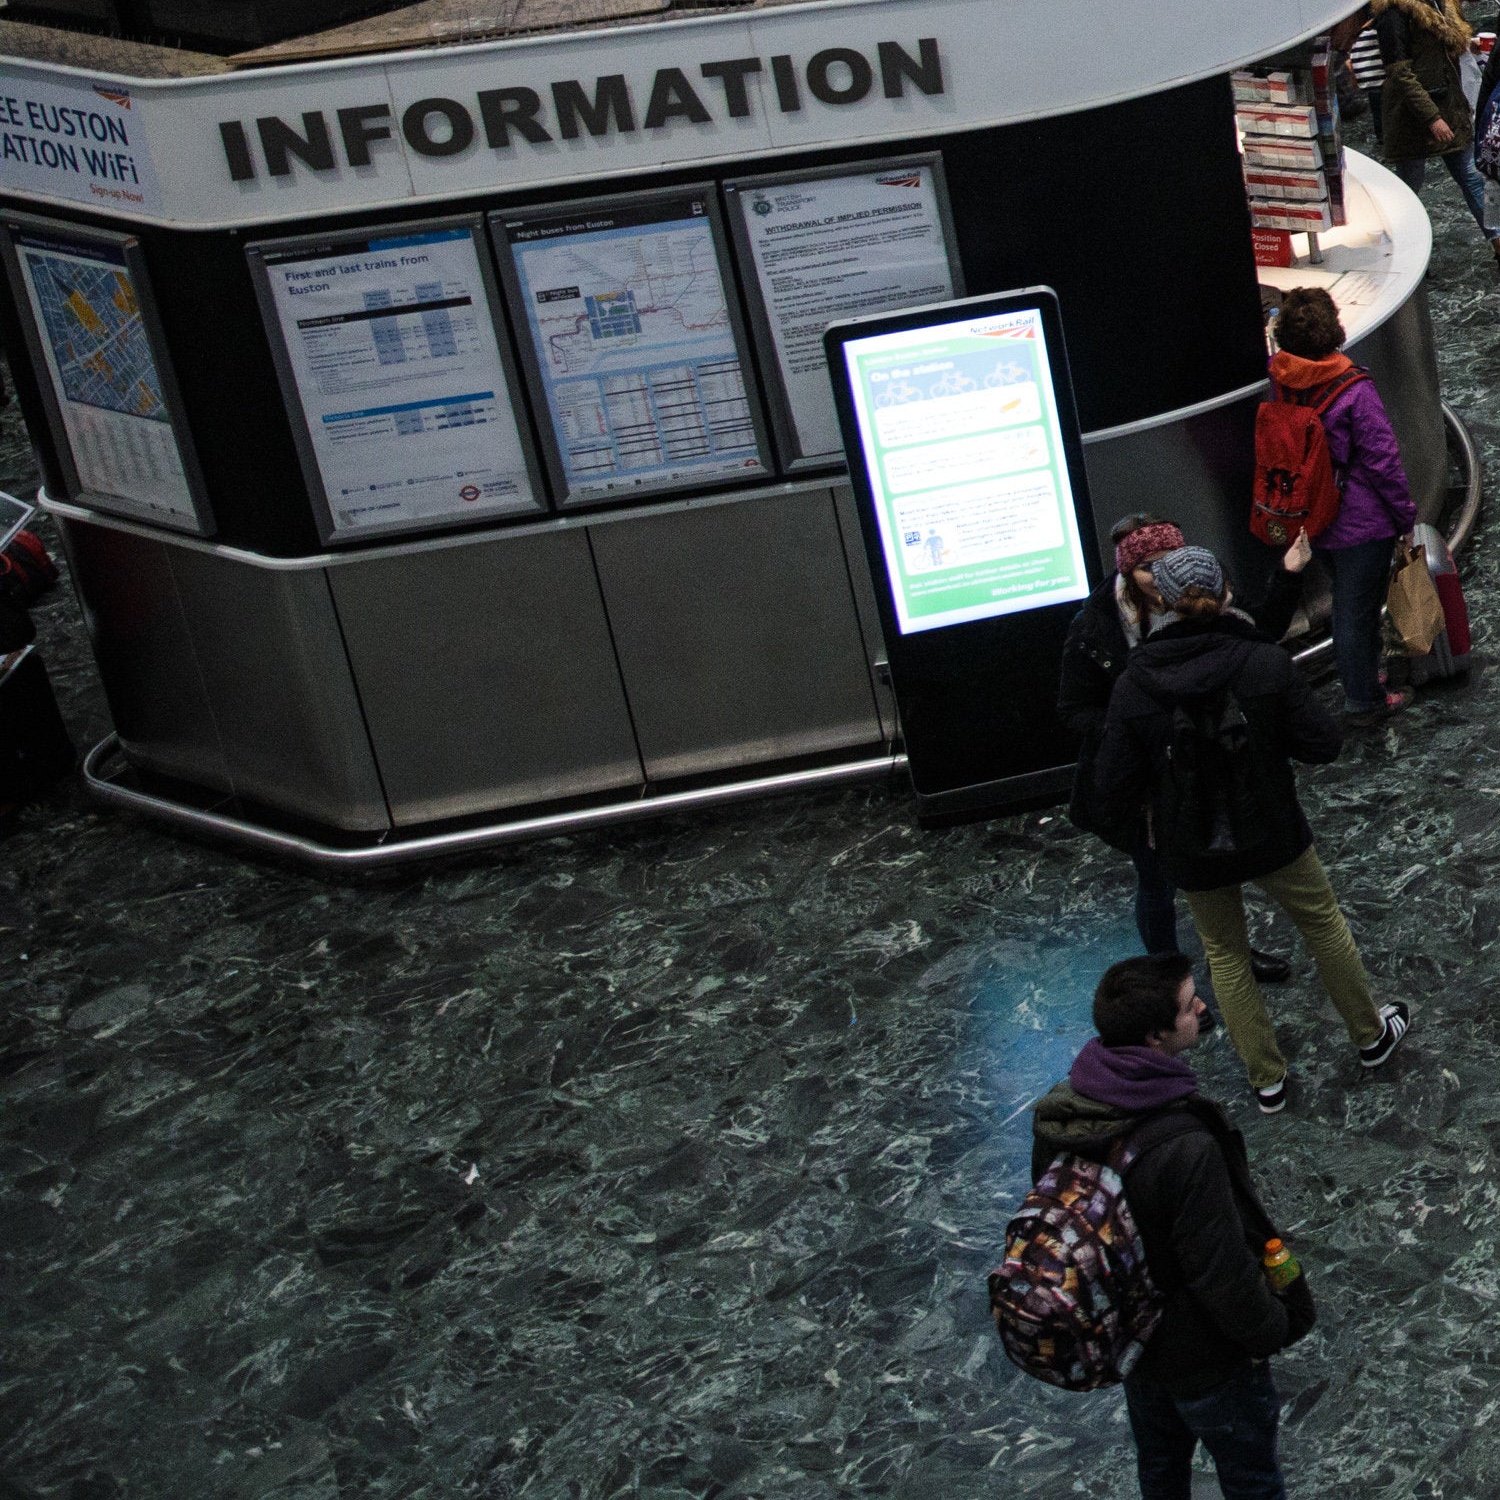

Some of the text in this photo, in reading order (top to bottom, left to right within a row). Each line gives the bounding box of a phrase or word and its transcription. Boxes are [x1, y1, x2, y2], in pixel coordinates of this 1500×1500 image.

[26, 101, 129, 146] EUSTON
[219, 35, 947, 185] INFORMATION
[82, 147, 139, 184] WiFi
[517, 218, 614, 240] Night buses from Euston
[765, 219, 821, 234] WITHDRAWAL
[837, 211, 870, 222] IMPLIED
[872, 202, 922, 217] PERMISSION
[1255, 243, 1279, 251] Closed
[285, 253, 429, 282] First and last trains from
[288, 282, 330, 296] Euston
[870, 371, 889, 382] On
